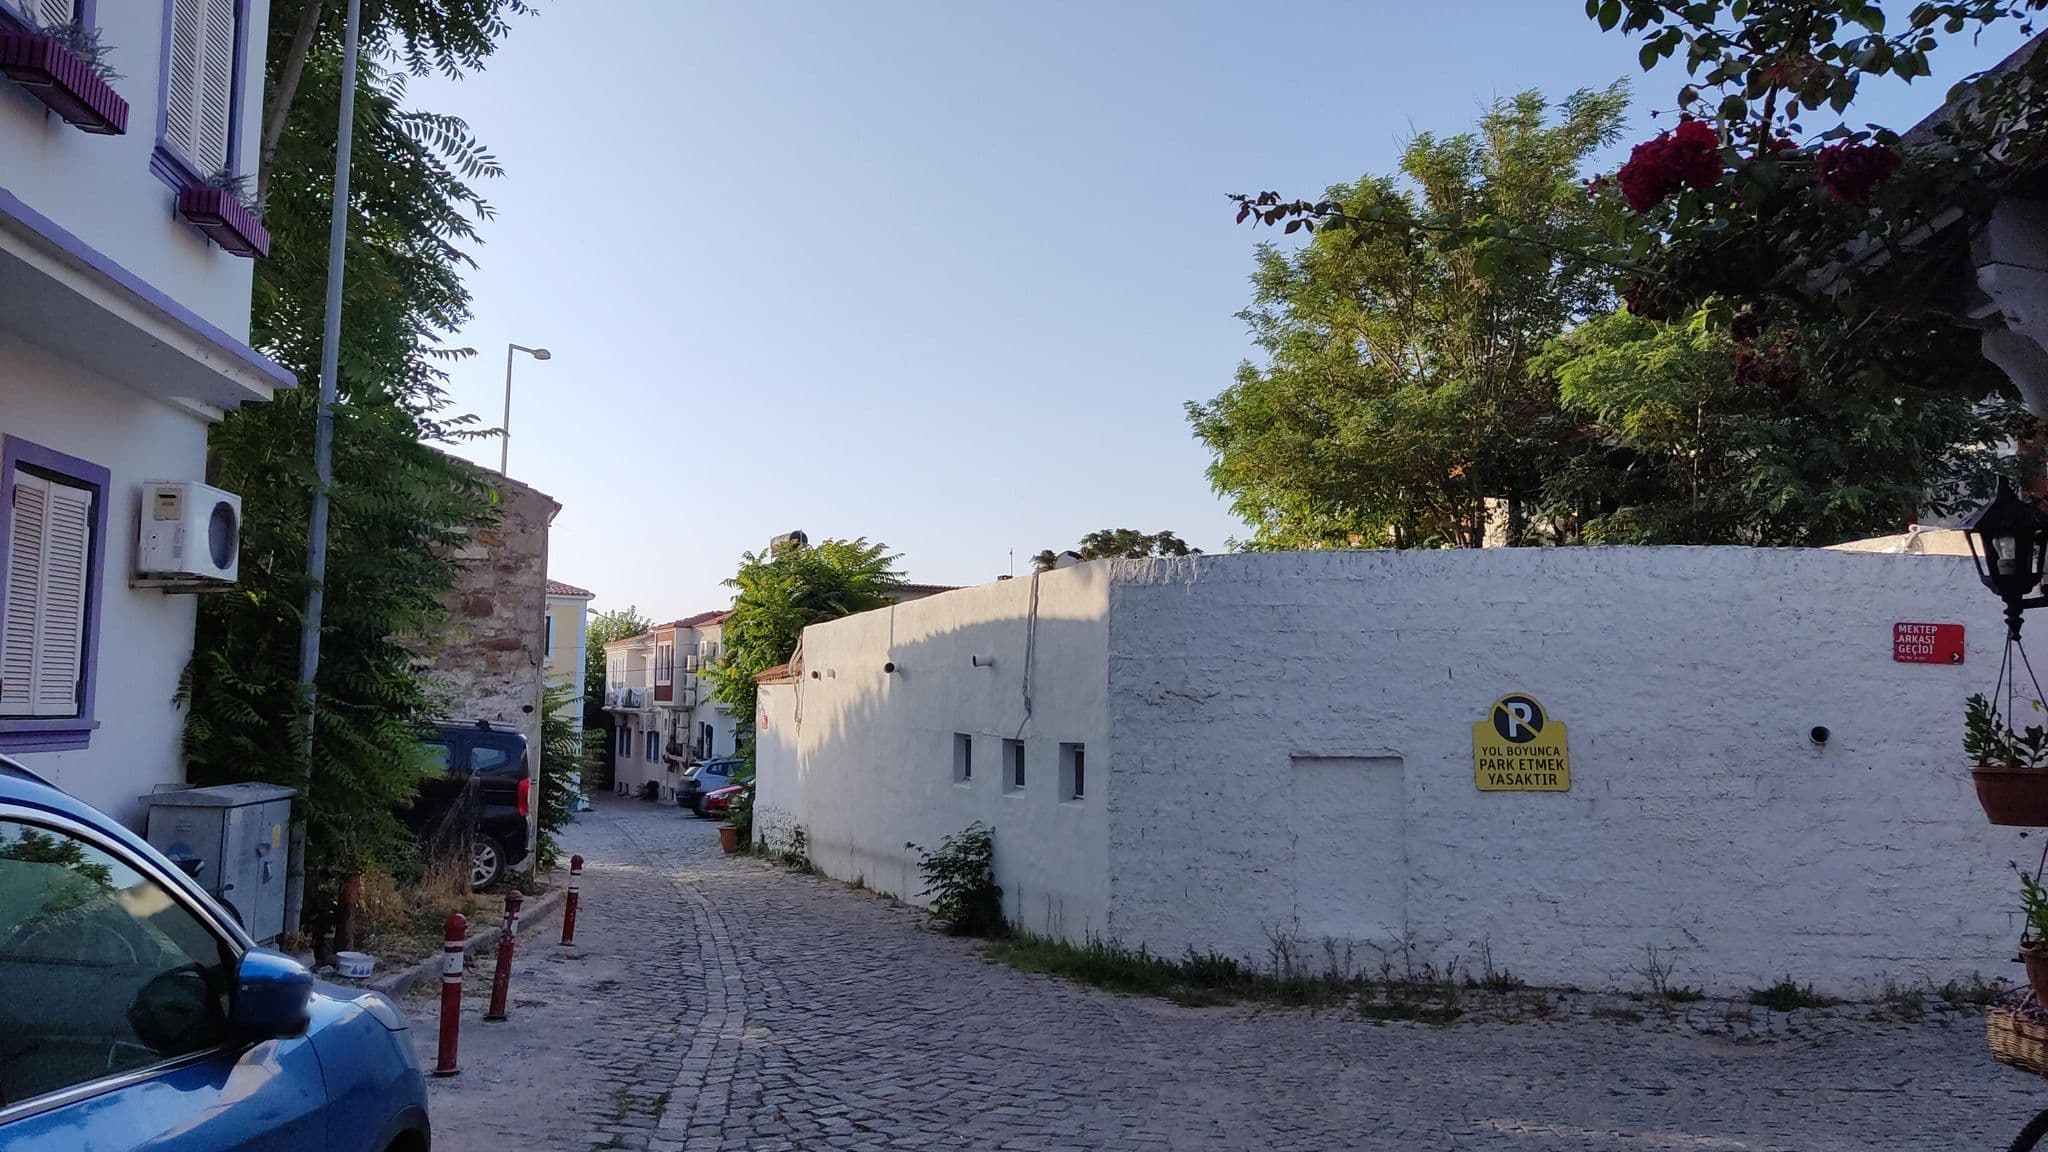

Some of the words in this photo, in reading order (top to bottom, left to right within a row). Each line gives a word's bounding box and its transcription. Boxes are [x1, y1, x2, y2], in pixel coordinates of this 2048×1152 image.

[1898, 624, 1938, 634] MEKTEP
[1897, 634, 1935, 644] ARKASI
[1898, 643, 1933, 656] GEÇİDİ
[1507, 702, 1533, 738] P
[1481, 746, 1503, 757] YOL
[1506, 746, 1561, 757] BOYUNCA
[1479, 758, 1515, 771] PARK
[1519, 758, 1565, 771] ETMEK
[1487, 773, 1558, 786] YASAKTIR
